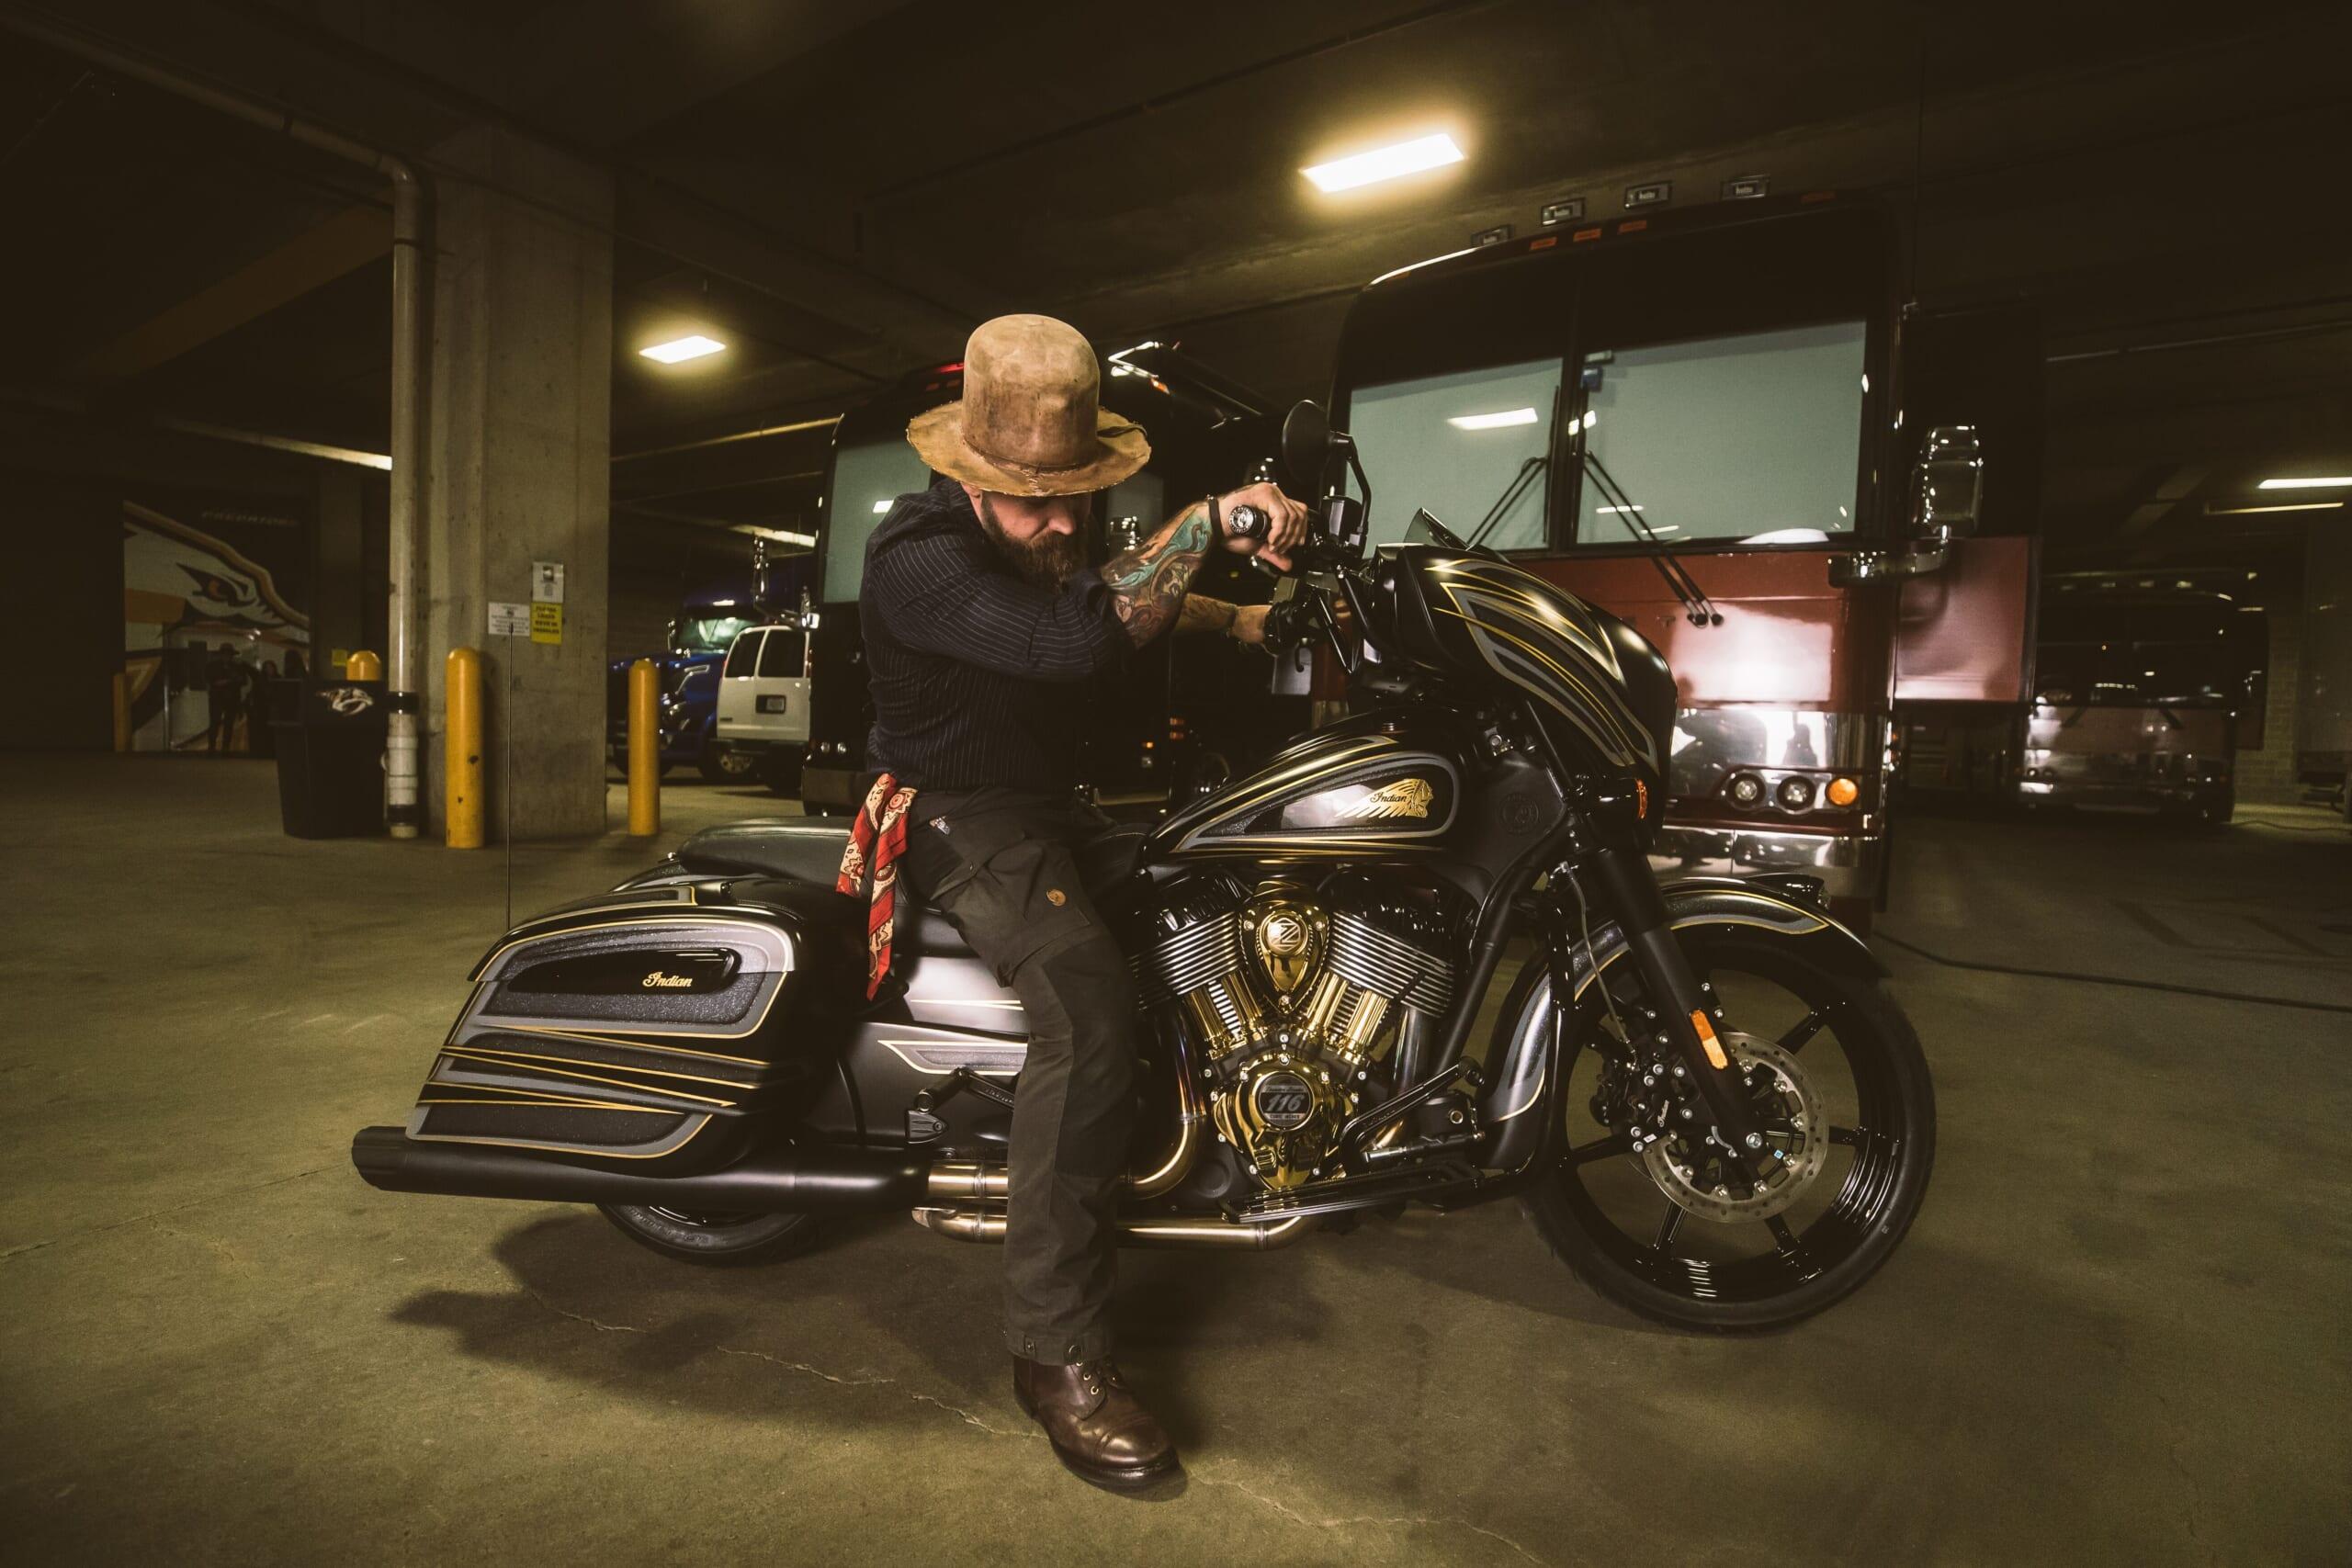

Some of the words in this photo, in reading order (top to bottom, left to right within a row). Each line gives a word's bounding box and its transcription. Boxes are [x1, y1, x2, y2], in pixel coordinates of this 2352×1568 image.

[1370, 791, 1407, 804] Indian
[642, 971, 693, 987] Indian
[1266, 1094, 1305, 1111] 116
